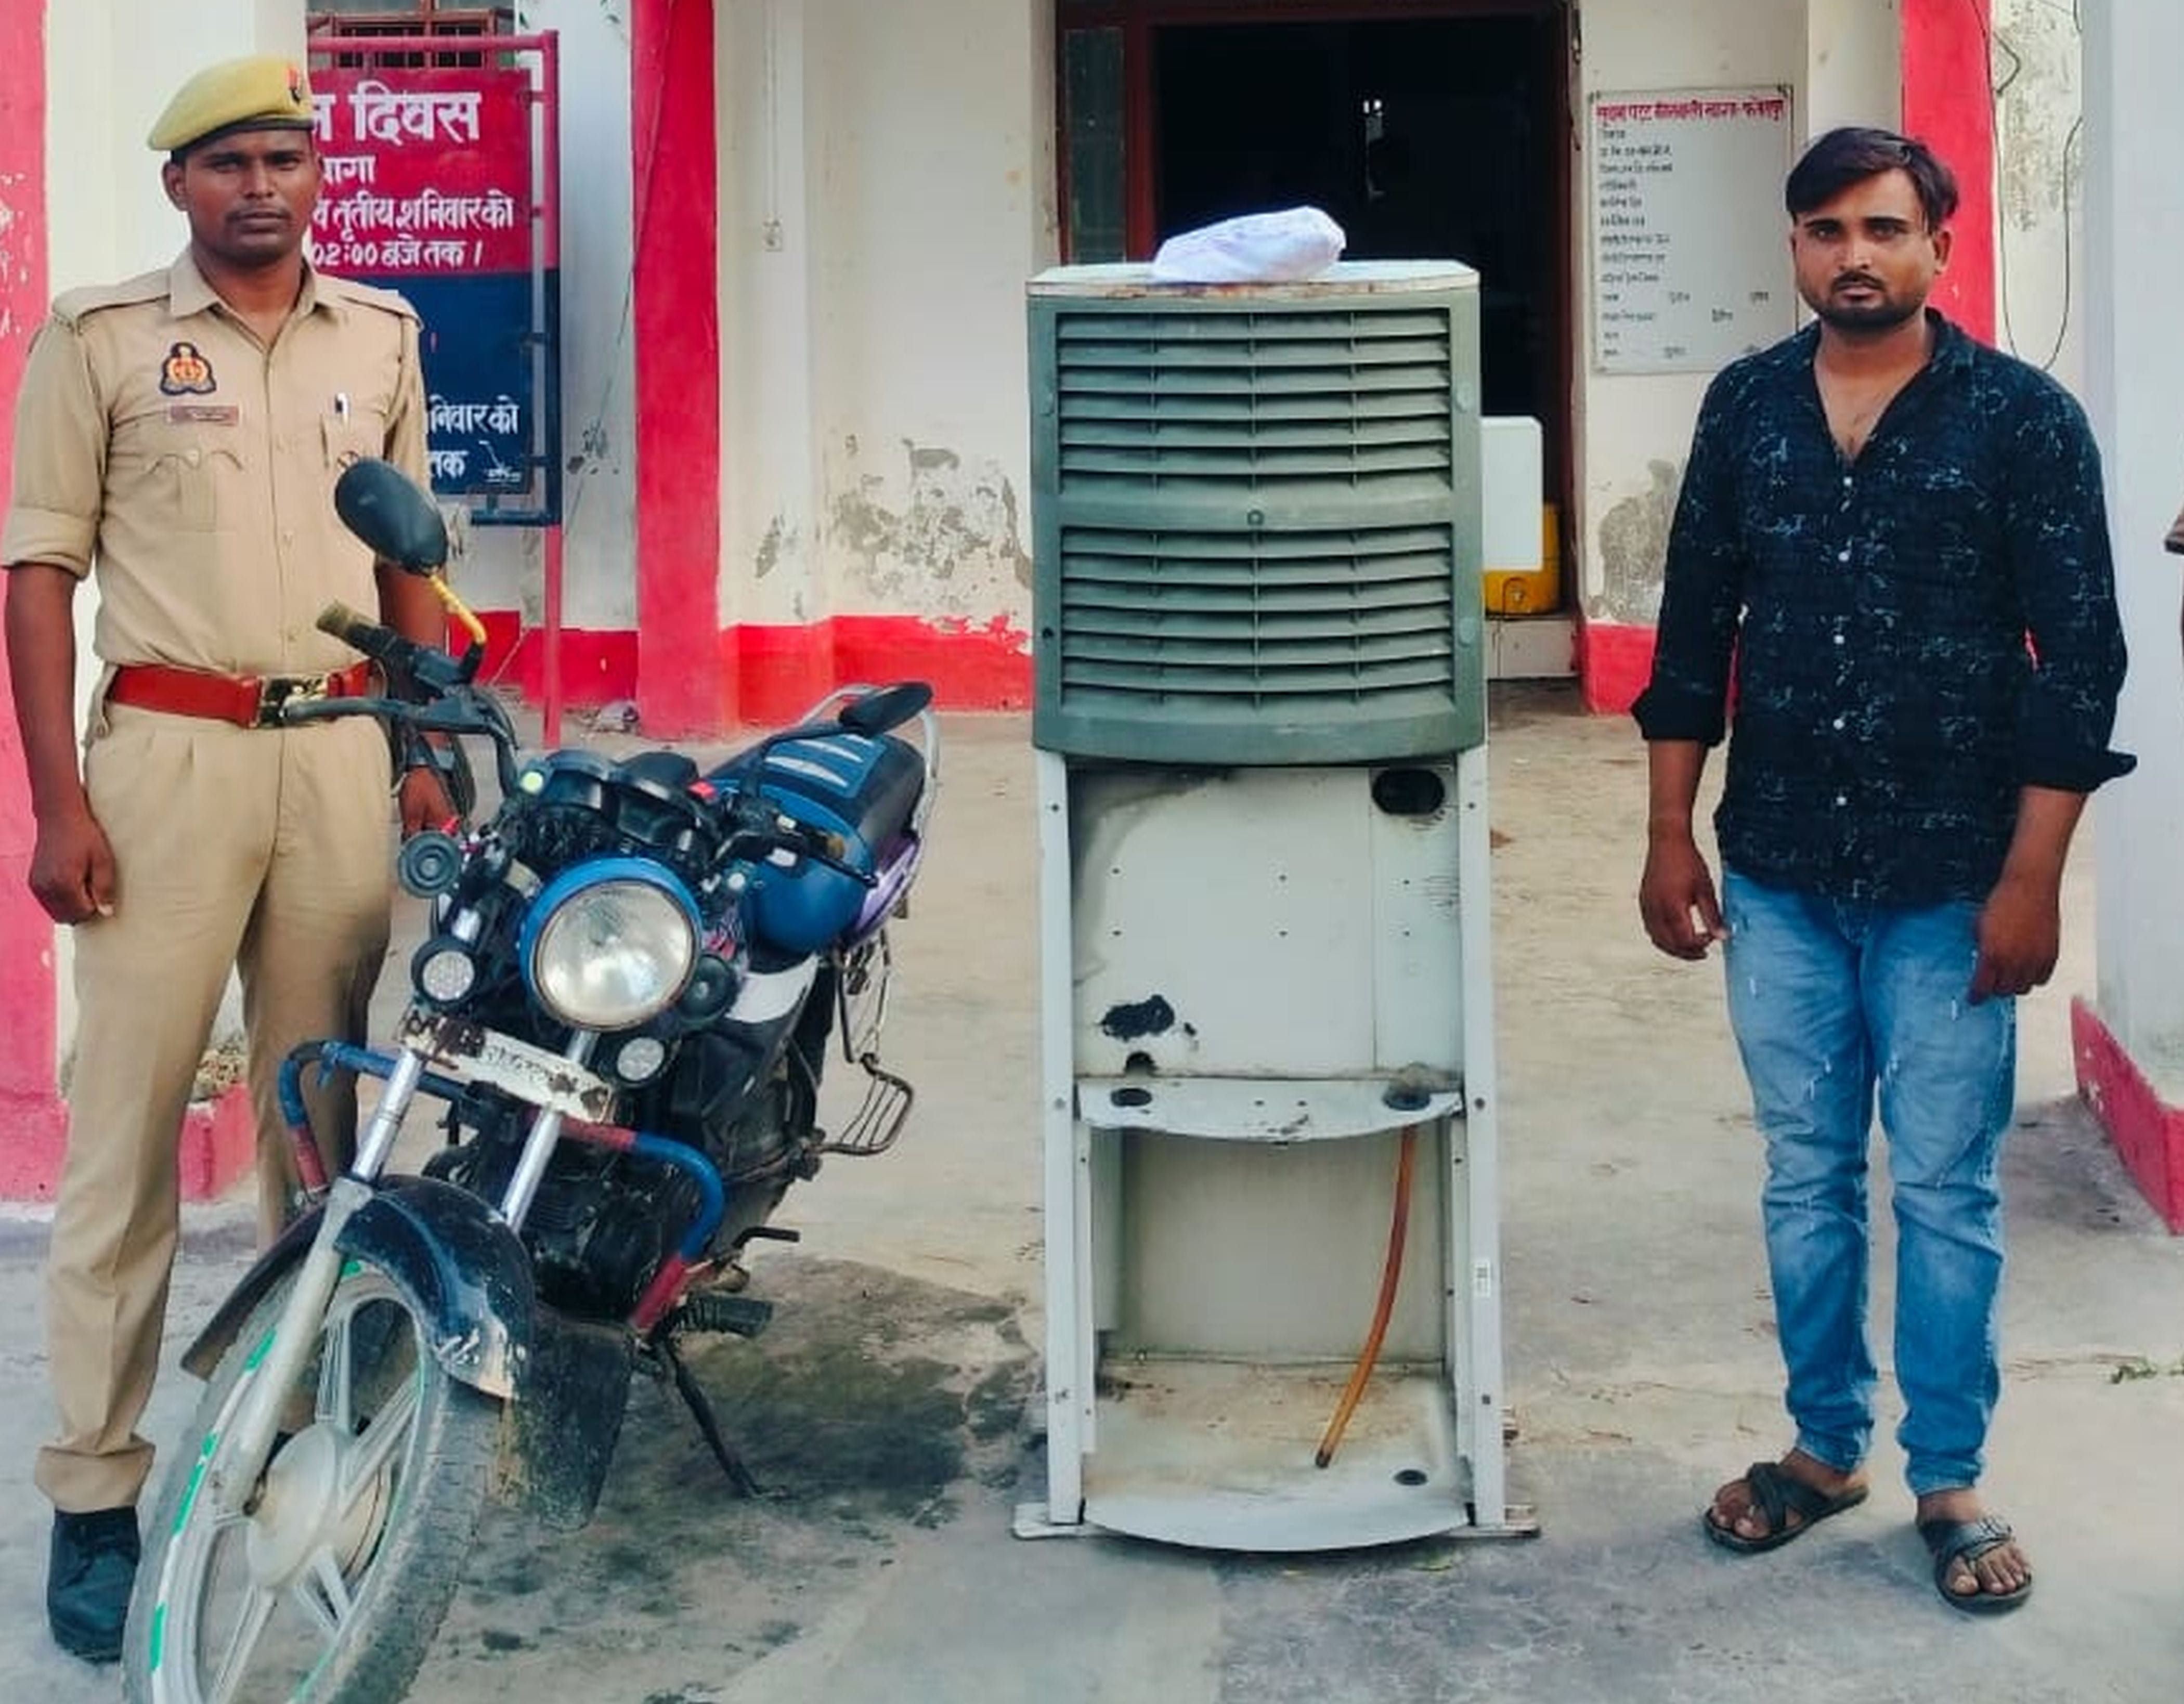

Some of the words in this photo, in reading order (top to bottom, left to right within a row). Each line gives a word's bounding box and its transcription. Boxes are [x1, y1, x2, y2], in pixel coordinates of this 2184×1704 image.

[347, 80, 482, 147] दिवस
[333, 190, 394, 241] तृतीय
[313, 242, 378, 267] 02:00
[381, 233, 422, 268] बजे
[423, 241, 468, 268] तक
[429, 394, 489, 434] निवार
